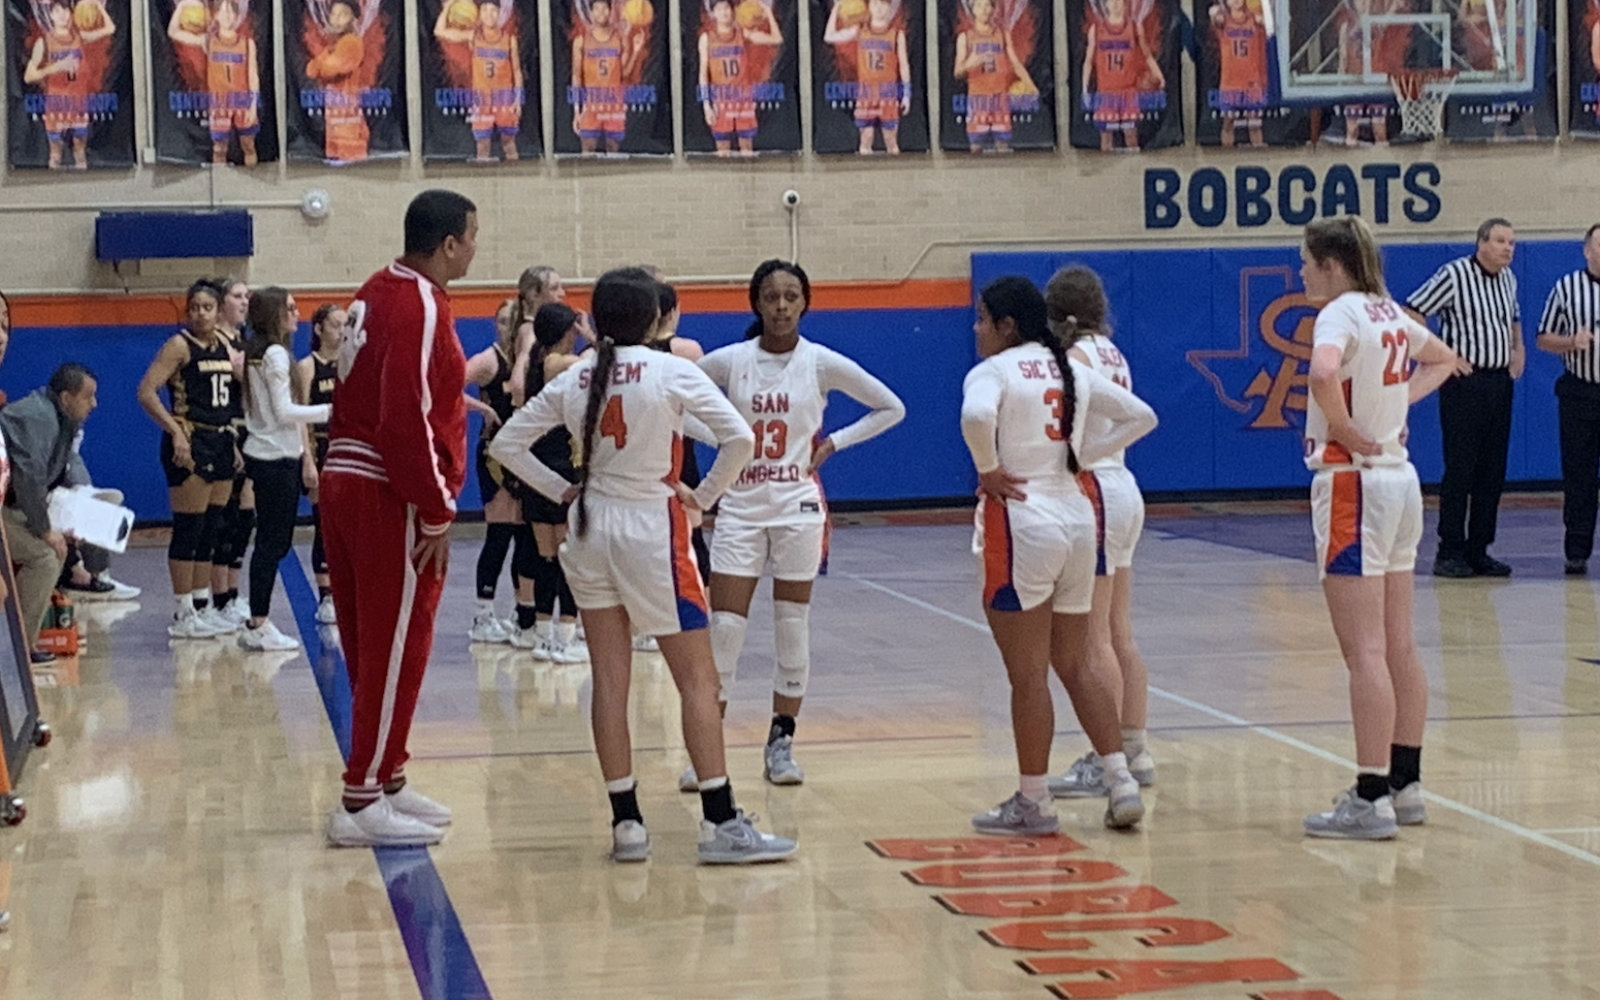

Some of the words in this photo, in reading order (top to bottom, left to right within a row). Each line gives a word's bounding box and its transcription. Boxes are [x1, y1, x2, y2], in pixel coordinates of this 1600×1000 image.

[1144, 162, 1441, 229] BOBCATS
[1017, 359, 1046, 380] SIC
[1381, 328, 1410, 387] 22
[210, 373, 232, 407] 15
[752, 394, 789, 414] SAN
[600, 394, 628, 450] 4
[1043, 387, 1066, 442] 3
[753, 418, 788, 460] 13
[735, 464, 799, 486] ANGELO
